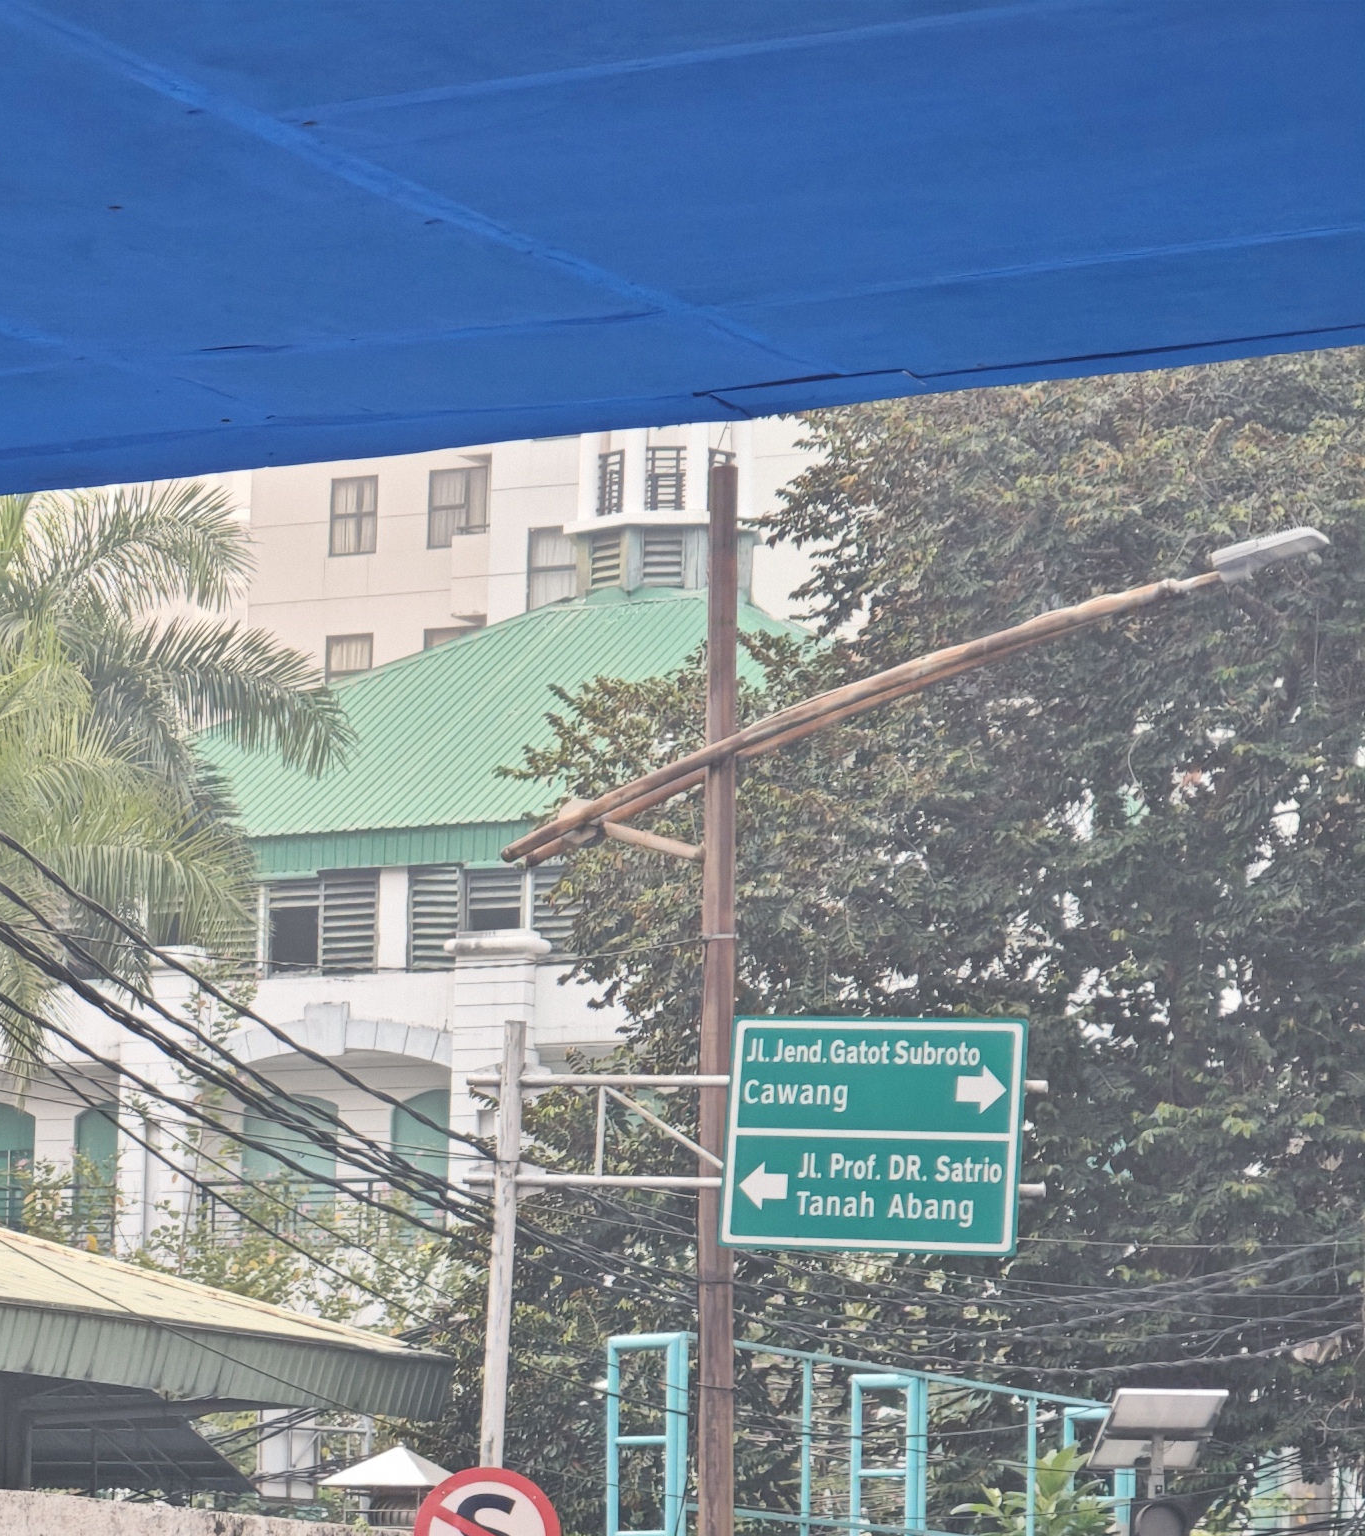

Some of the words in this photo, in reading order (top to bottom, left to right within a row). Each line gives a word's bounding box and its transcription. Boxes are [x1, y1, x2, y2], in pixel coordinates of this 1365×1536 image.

[746, 1038, 769, 1063] Jl.
[773, 1038, 827, 1064] Jend.
[829, 1039, 890, 1065] Gatot
[893, 1040, 981, 1067] Subroto
[744, 1079, 849, 1113] Cawang
[798, 1152, 821, 1179] Jl.
[830, 1153, 880, 1181] Prof.
[889, 1155, 927, 1182] DR.
[935, 1156, 1003, 1184] Satrio
[797, 1191, 875, 1218] Tanah
[888, 1194, 974, 1228] Abang
